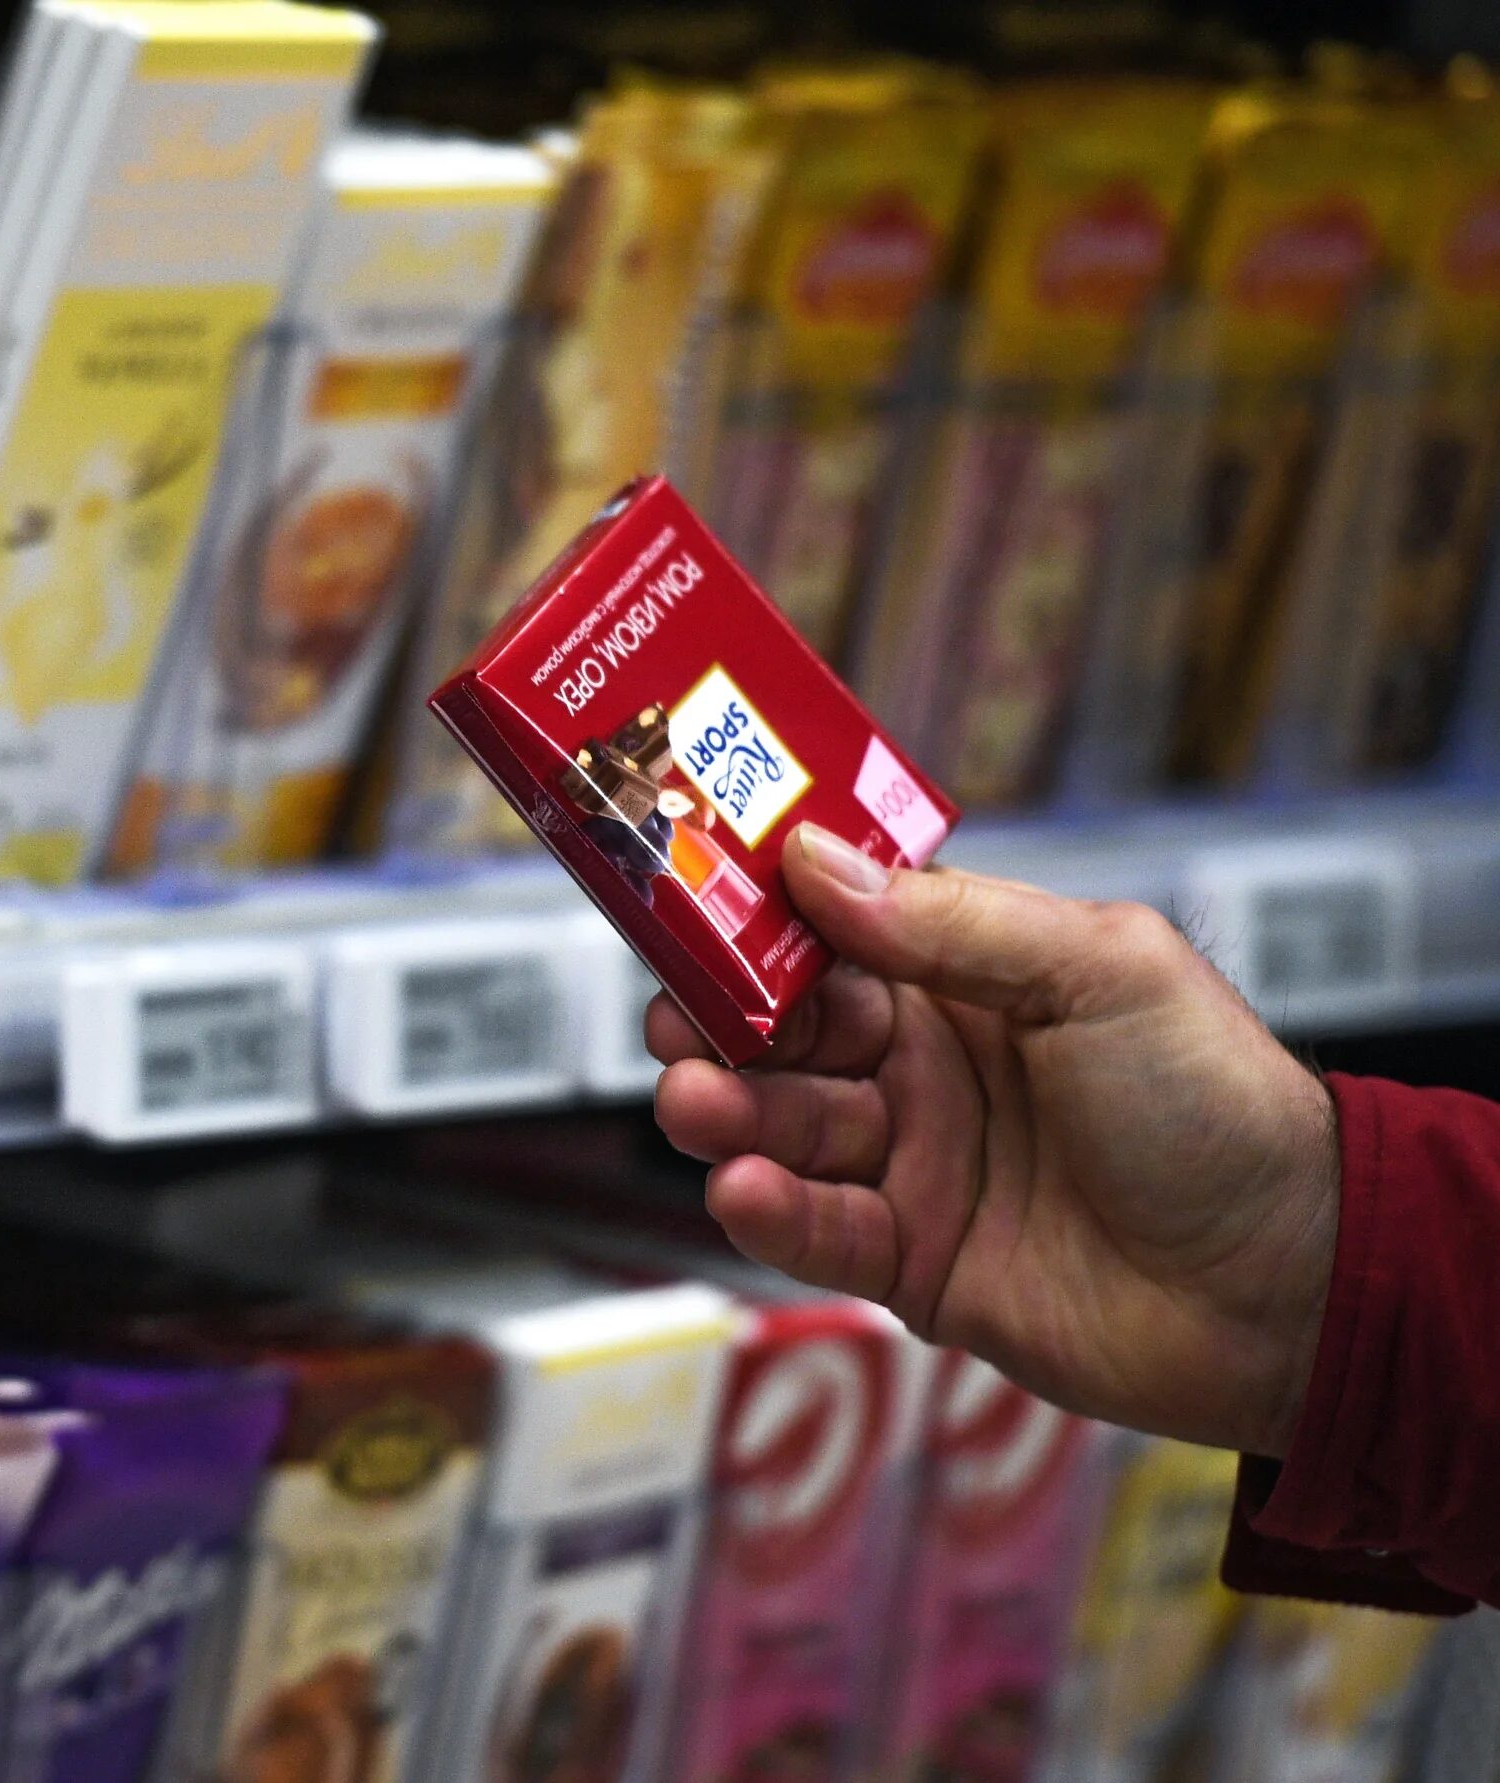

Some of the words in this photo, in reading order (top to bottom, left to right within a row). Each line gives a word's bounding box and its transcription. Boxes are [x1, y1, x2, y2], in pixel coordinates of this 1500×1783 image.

[646, 551, 704, 609] РОМ,
[591, 593, 666, 669] ИЗЮМ,
[531, 645, 563, 687] ромом
[553, 658, 606, 717] ОРЕХ
[685, 701, 748, 776] SPORT
[713, 732, 785, 818] Ritter
